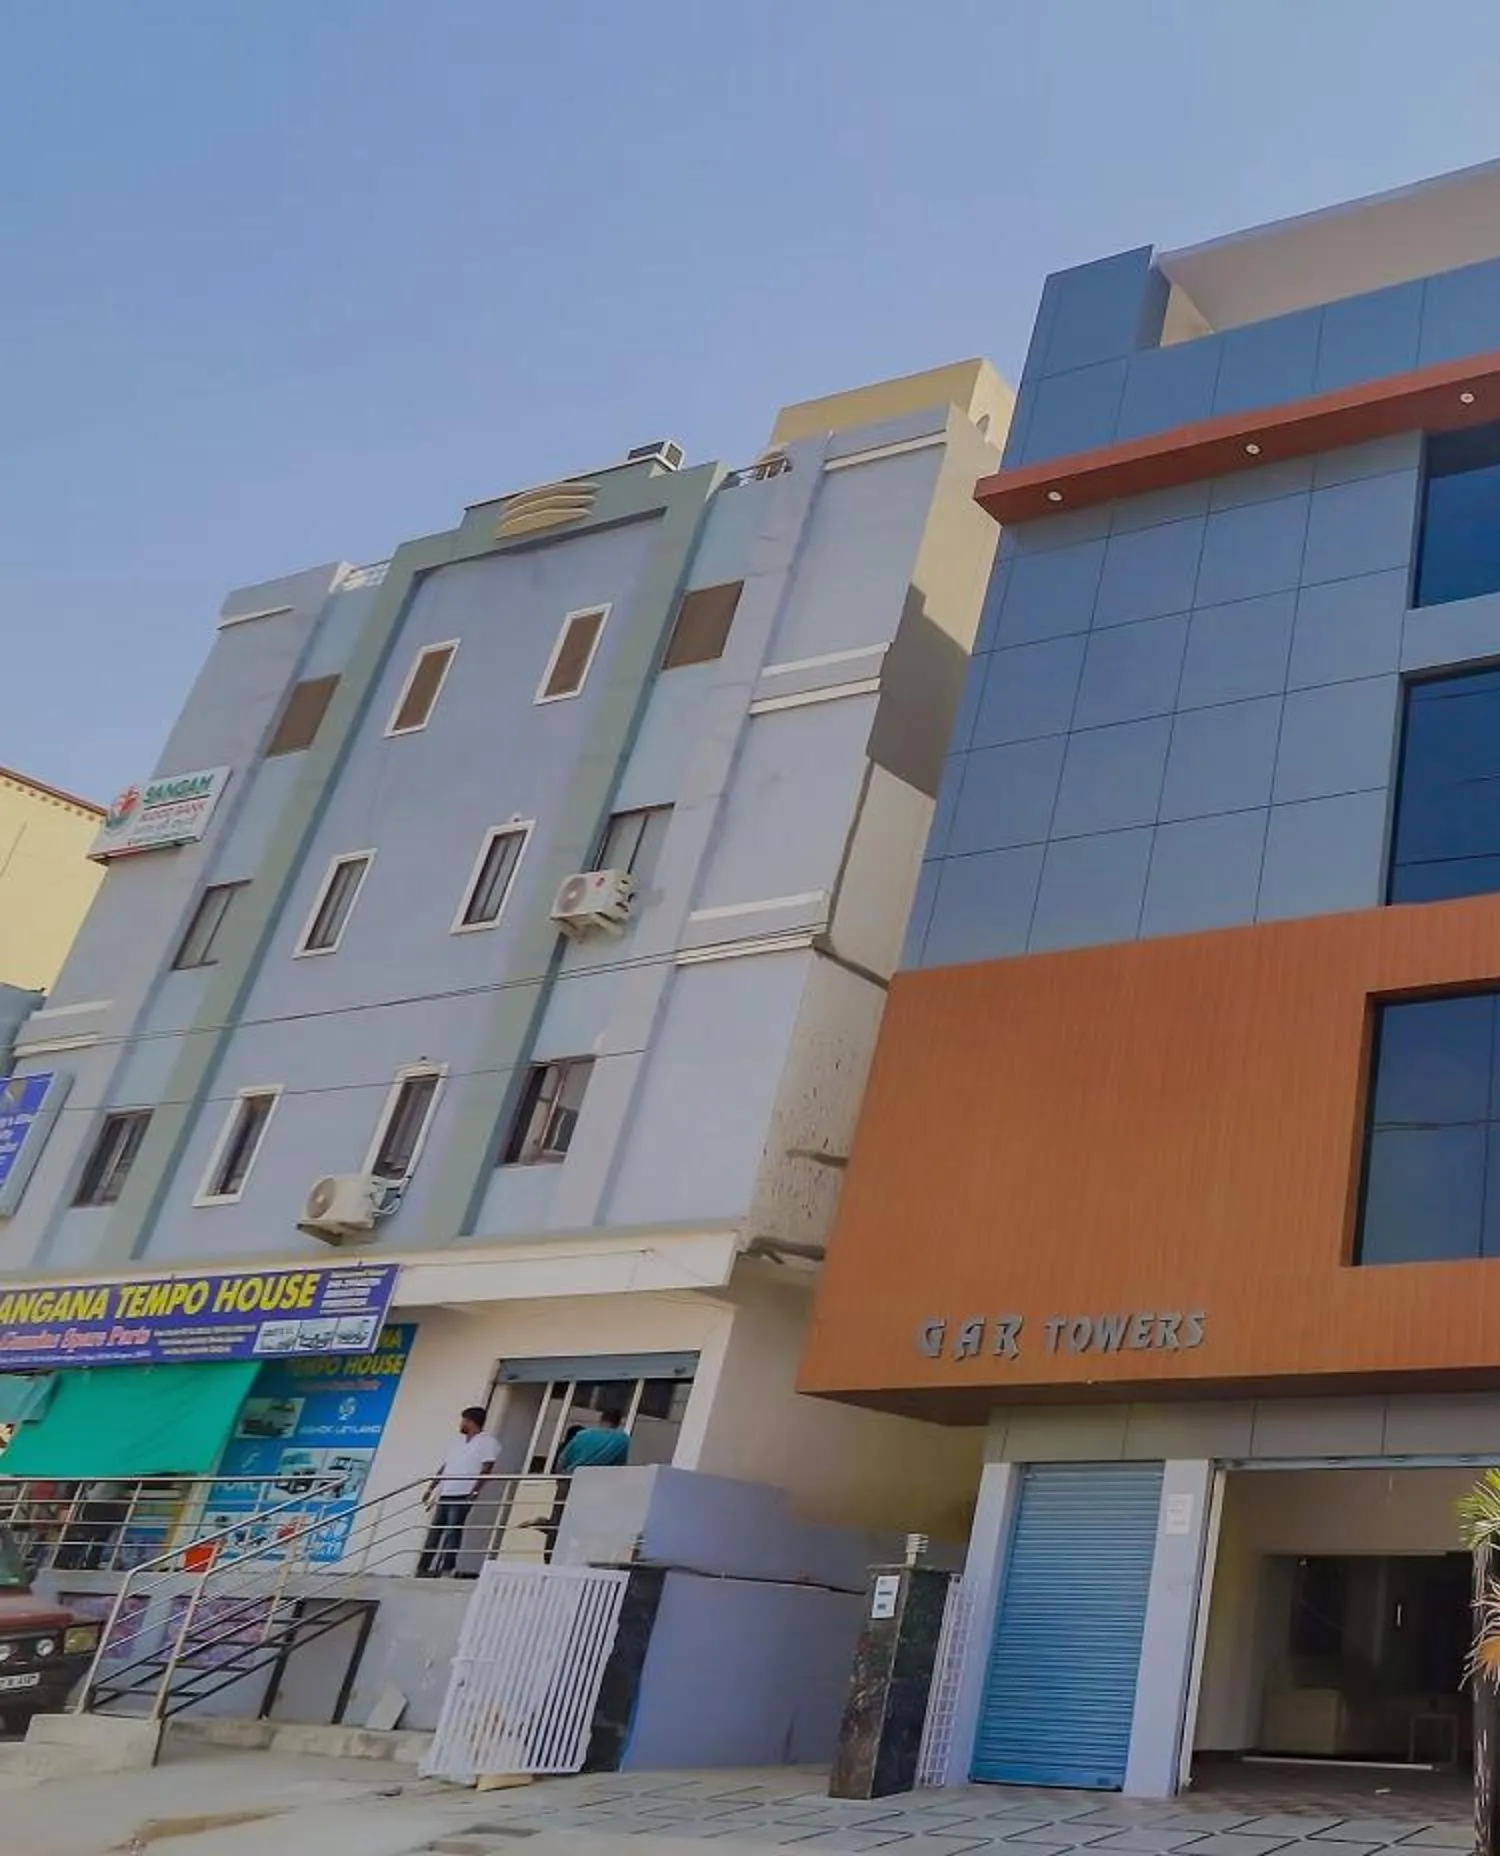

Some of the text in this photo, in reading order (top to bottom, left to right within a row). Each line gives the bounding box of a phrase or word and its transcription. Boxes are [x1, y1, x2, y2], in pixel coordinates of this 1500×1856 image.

[114, 1278, 209, 1318] TEMPO
[212, 1274, 321, 1312] HOUSE
[1043, 1310, 1206, 1354] TOWERS
[343, 1354, 406, 1376] HOUSE
